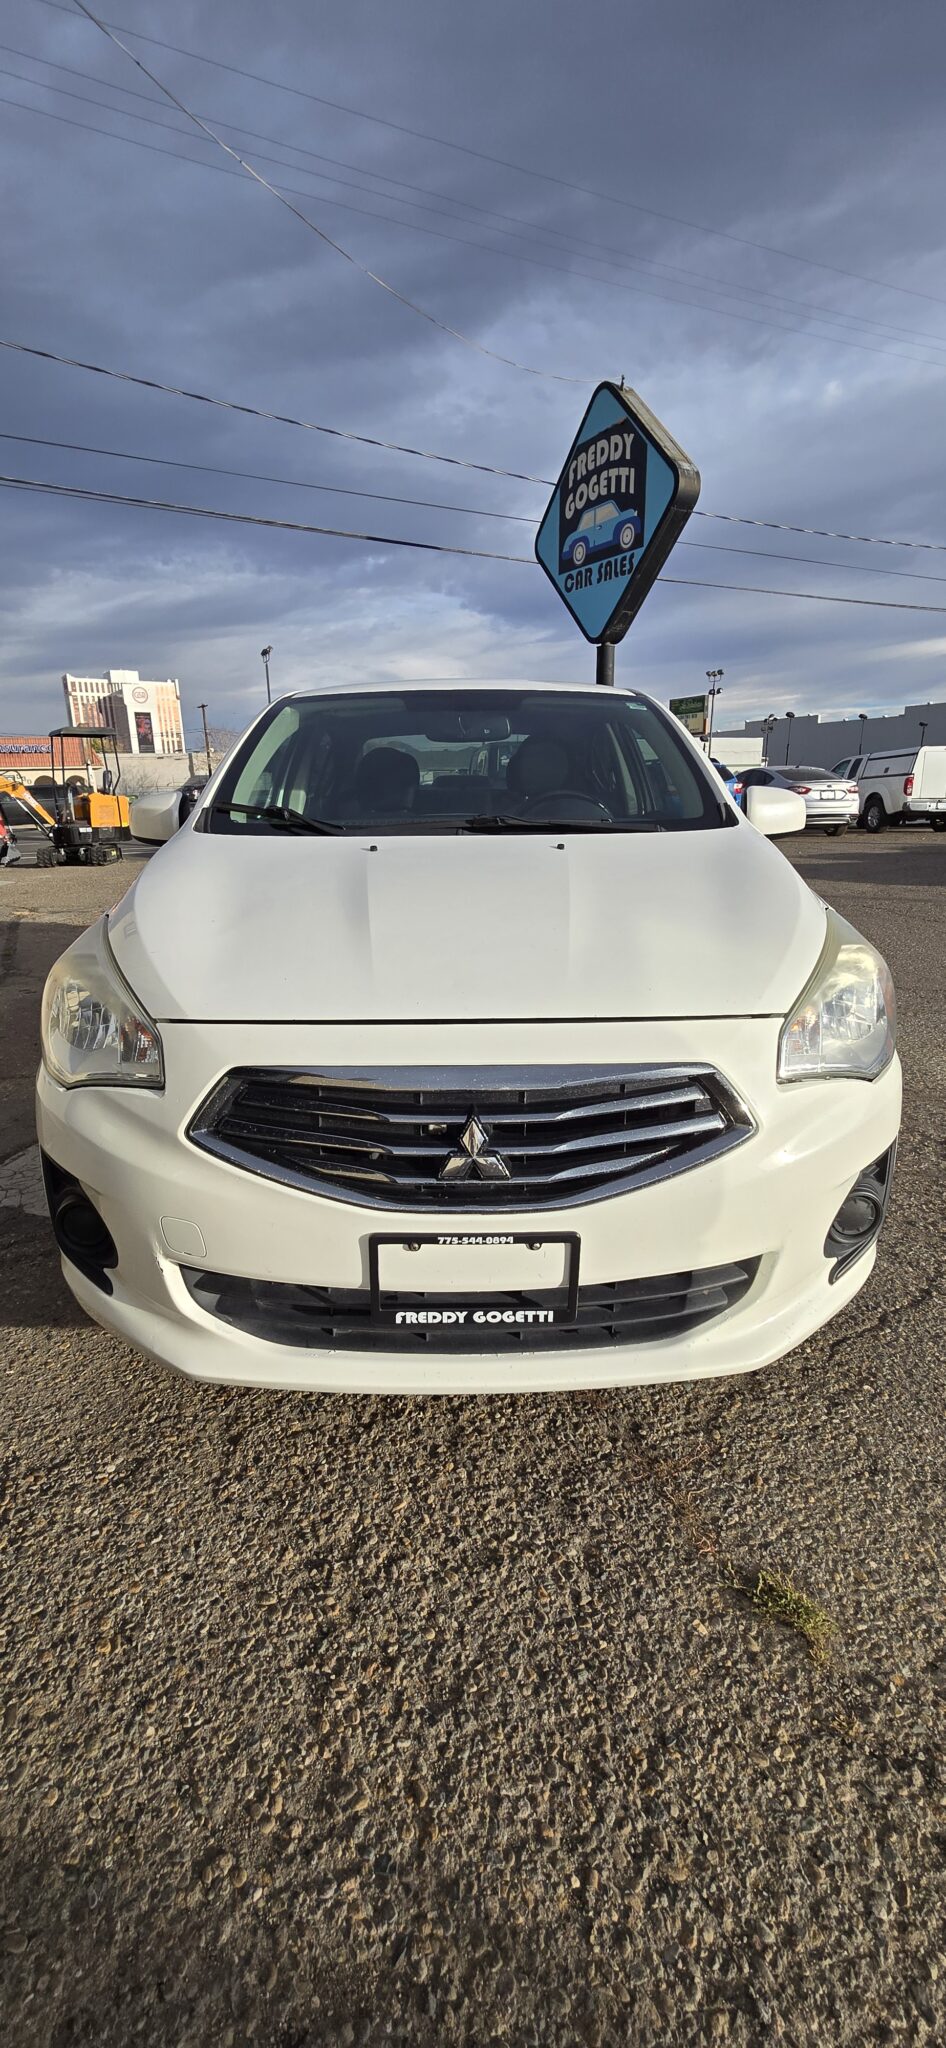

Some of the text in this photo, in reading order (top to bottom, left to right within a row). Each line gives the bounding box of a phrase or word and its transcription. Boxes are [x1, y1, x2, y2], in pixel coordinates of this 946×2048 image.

[568, 433, 635, 489] FREDDY
[565, 467, 635, 520] GOGETTI
[564, 552, 635, 593] CAR SALES
[437, 1236, 514, 1245] 775-544-0894
[395, 1310, 554, 1324] FREDDY GOGETTI
